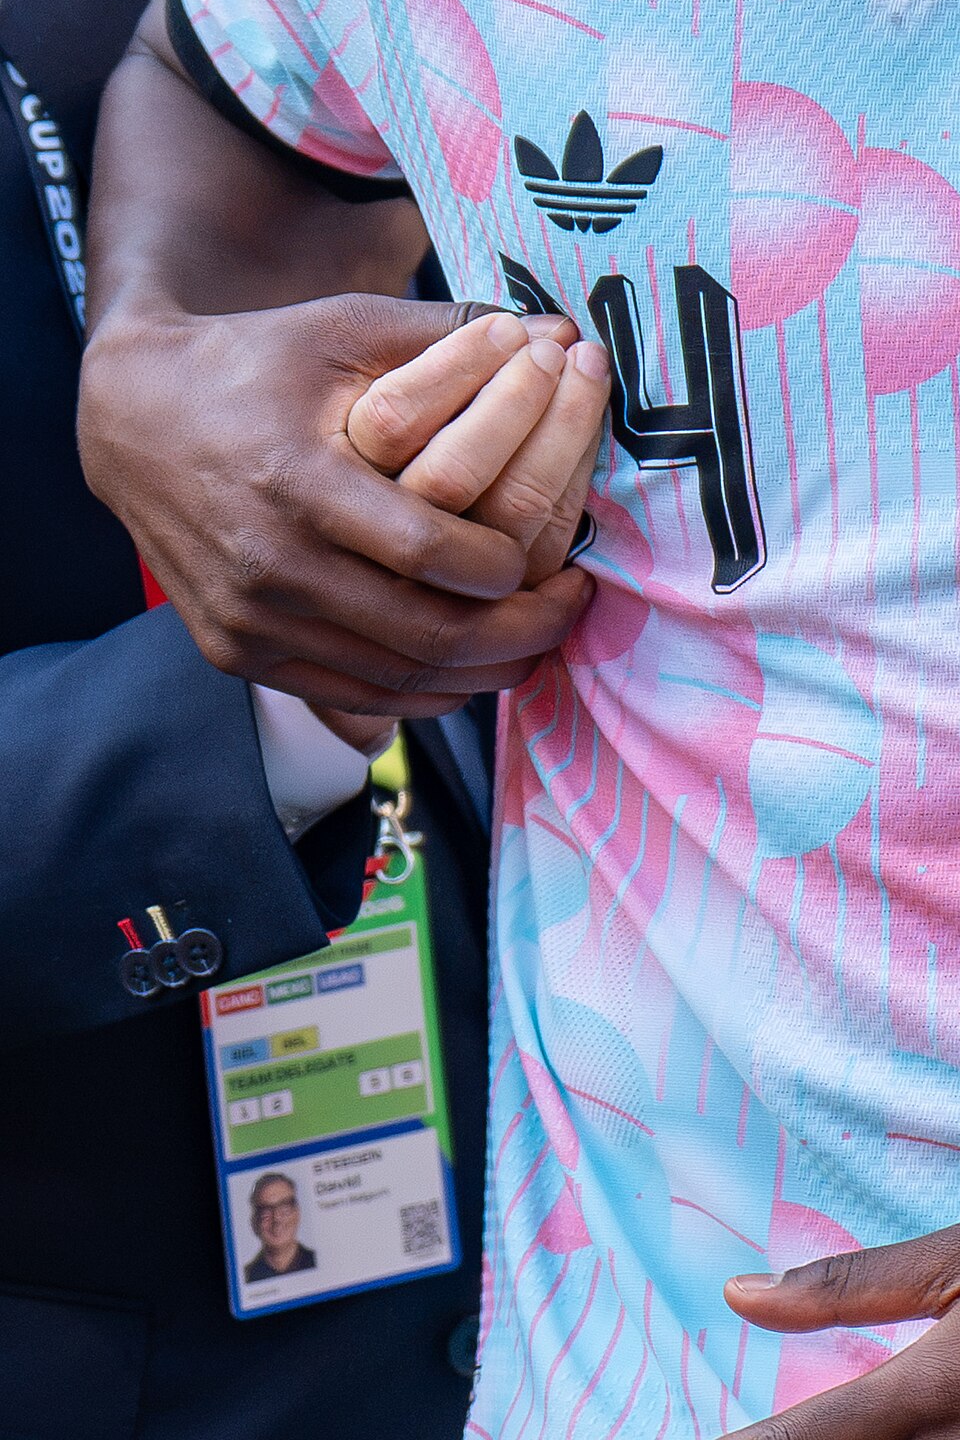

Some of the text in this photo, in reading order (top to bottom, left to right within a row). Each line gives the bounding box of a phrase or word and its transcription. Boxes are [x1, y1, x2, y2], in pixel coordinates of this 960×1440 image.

[20, 92, 66, 180] CUP
[498, 250, 768, 594] 4
[228, 1052, 355, 1093] TEAM DELEGATE
